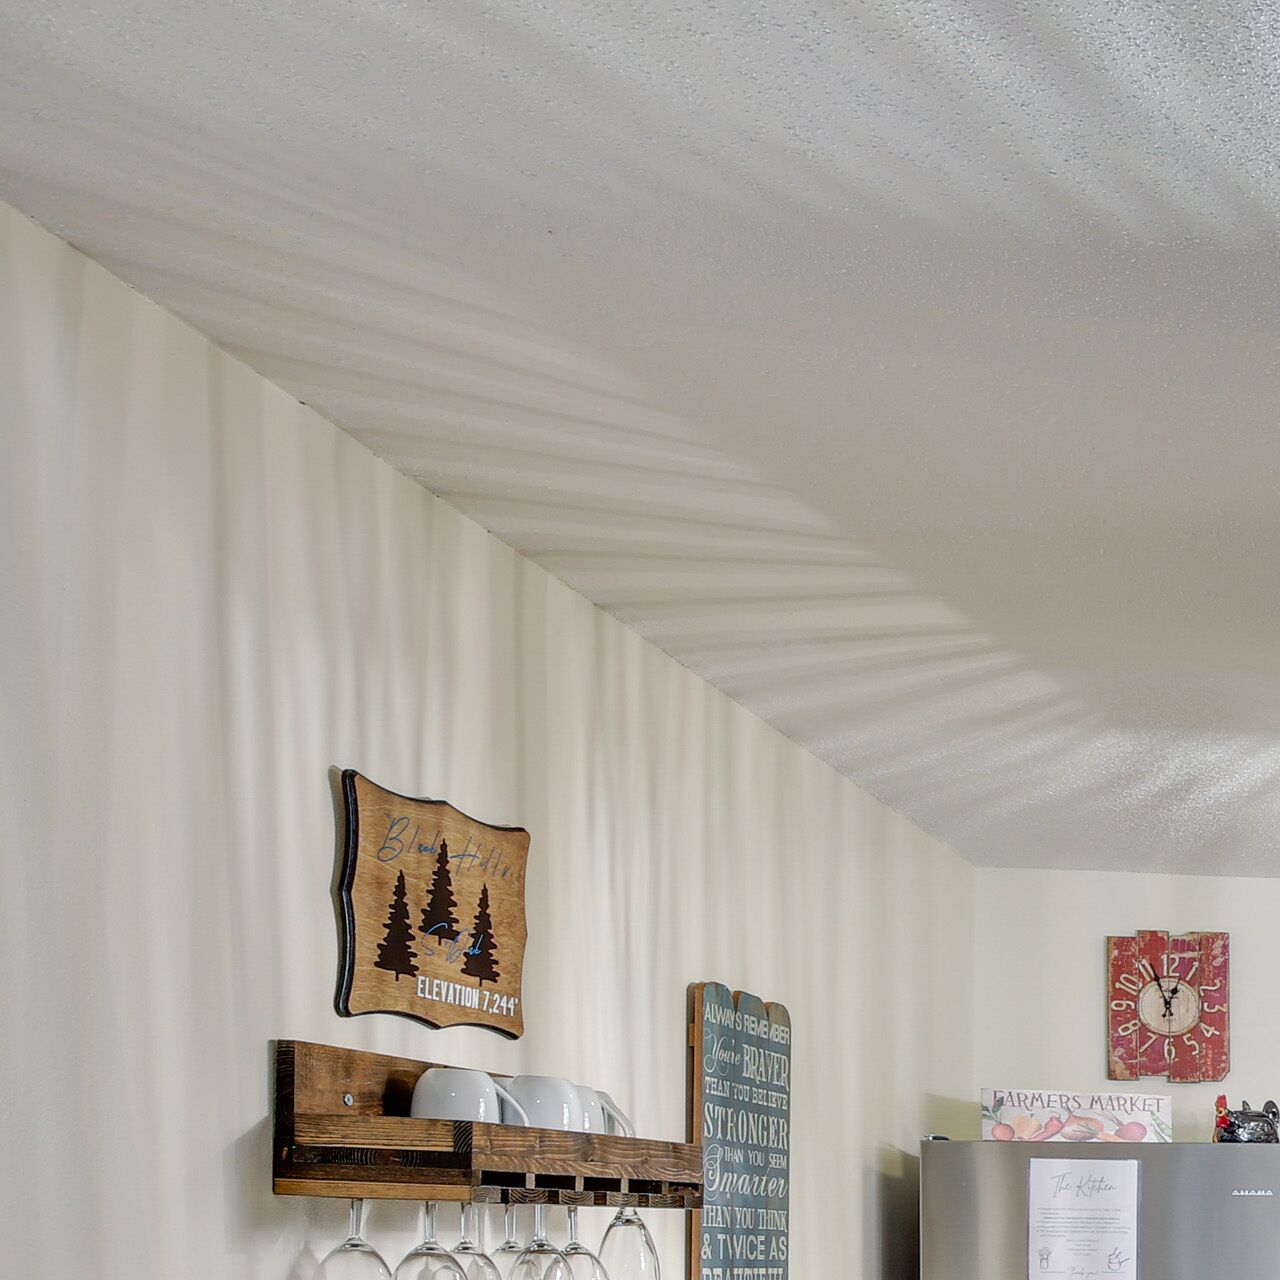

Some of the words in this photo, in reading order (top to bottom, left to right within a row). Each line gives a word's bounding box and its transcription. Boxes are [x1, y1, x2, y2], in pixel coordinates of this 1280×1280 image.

[1161, 954, 1180, 976] 12
[417, 975, 480, 1009] ELEVATION
[482, 991, 519, 1017] 7,244'
[704, 1002, 742, 1031] ALWAYS
[743, 1014, 790, 1045] REMEMBER
[703, 1028, 741, 1076] You're
[742, 1044, 789, 1091] BRAVER
[704, 1076, 730, 1098] THAN
[732, 1082, 750, 1102] YOU
[752, 1087, 788, 1109] BELIEVE
[993, 1090, 1082, 1112] FARMERS
[1089, 1095, 1165, 1115] MARKET
[704, 1102, 787, 1150] STRONGER
[703, 1143, 789, 1200] Smarter
[724, 1146, 743, 1163] THAN
[748, 1150, 764, 1166] YOU
[769, 1153, 787, 1169] SEEM
[702, 1204, 731, 1228] THAN
[735, 1207, 755, 1229] YOU
[757, 1208, 787, 1232] THINK
[701, 1233, 712, 1259] &
[717, 1234, 765, 1260] TWICE
[769, 1236, 787, 1260] AS
